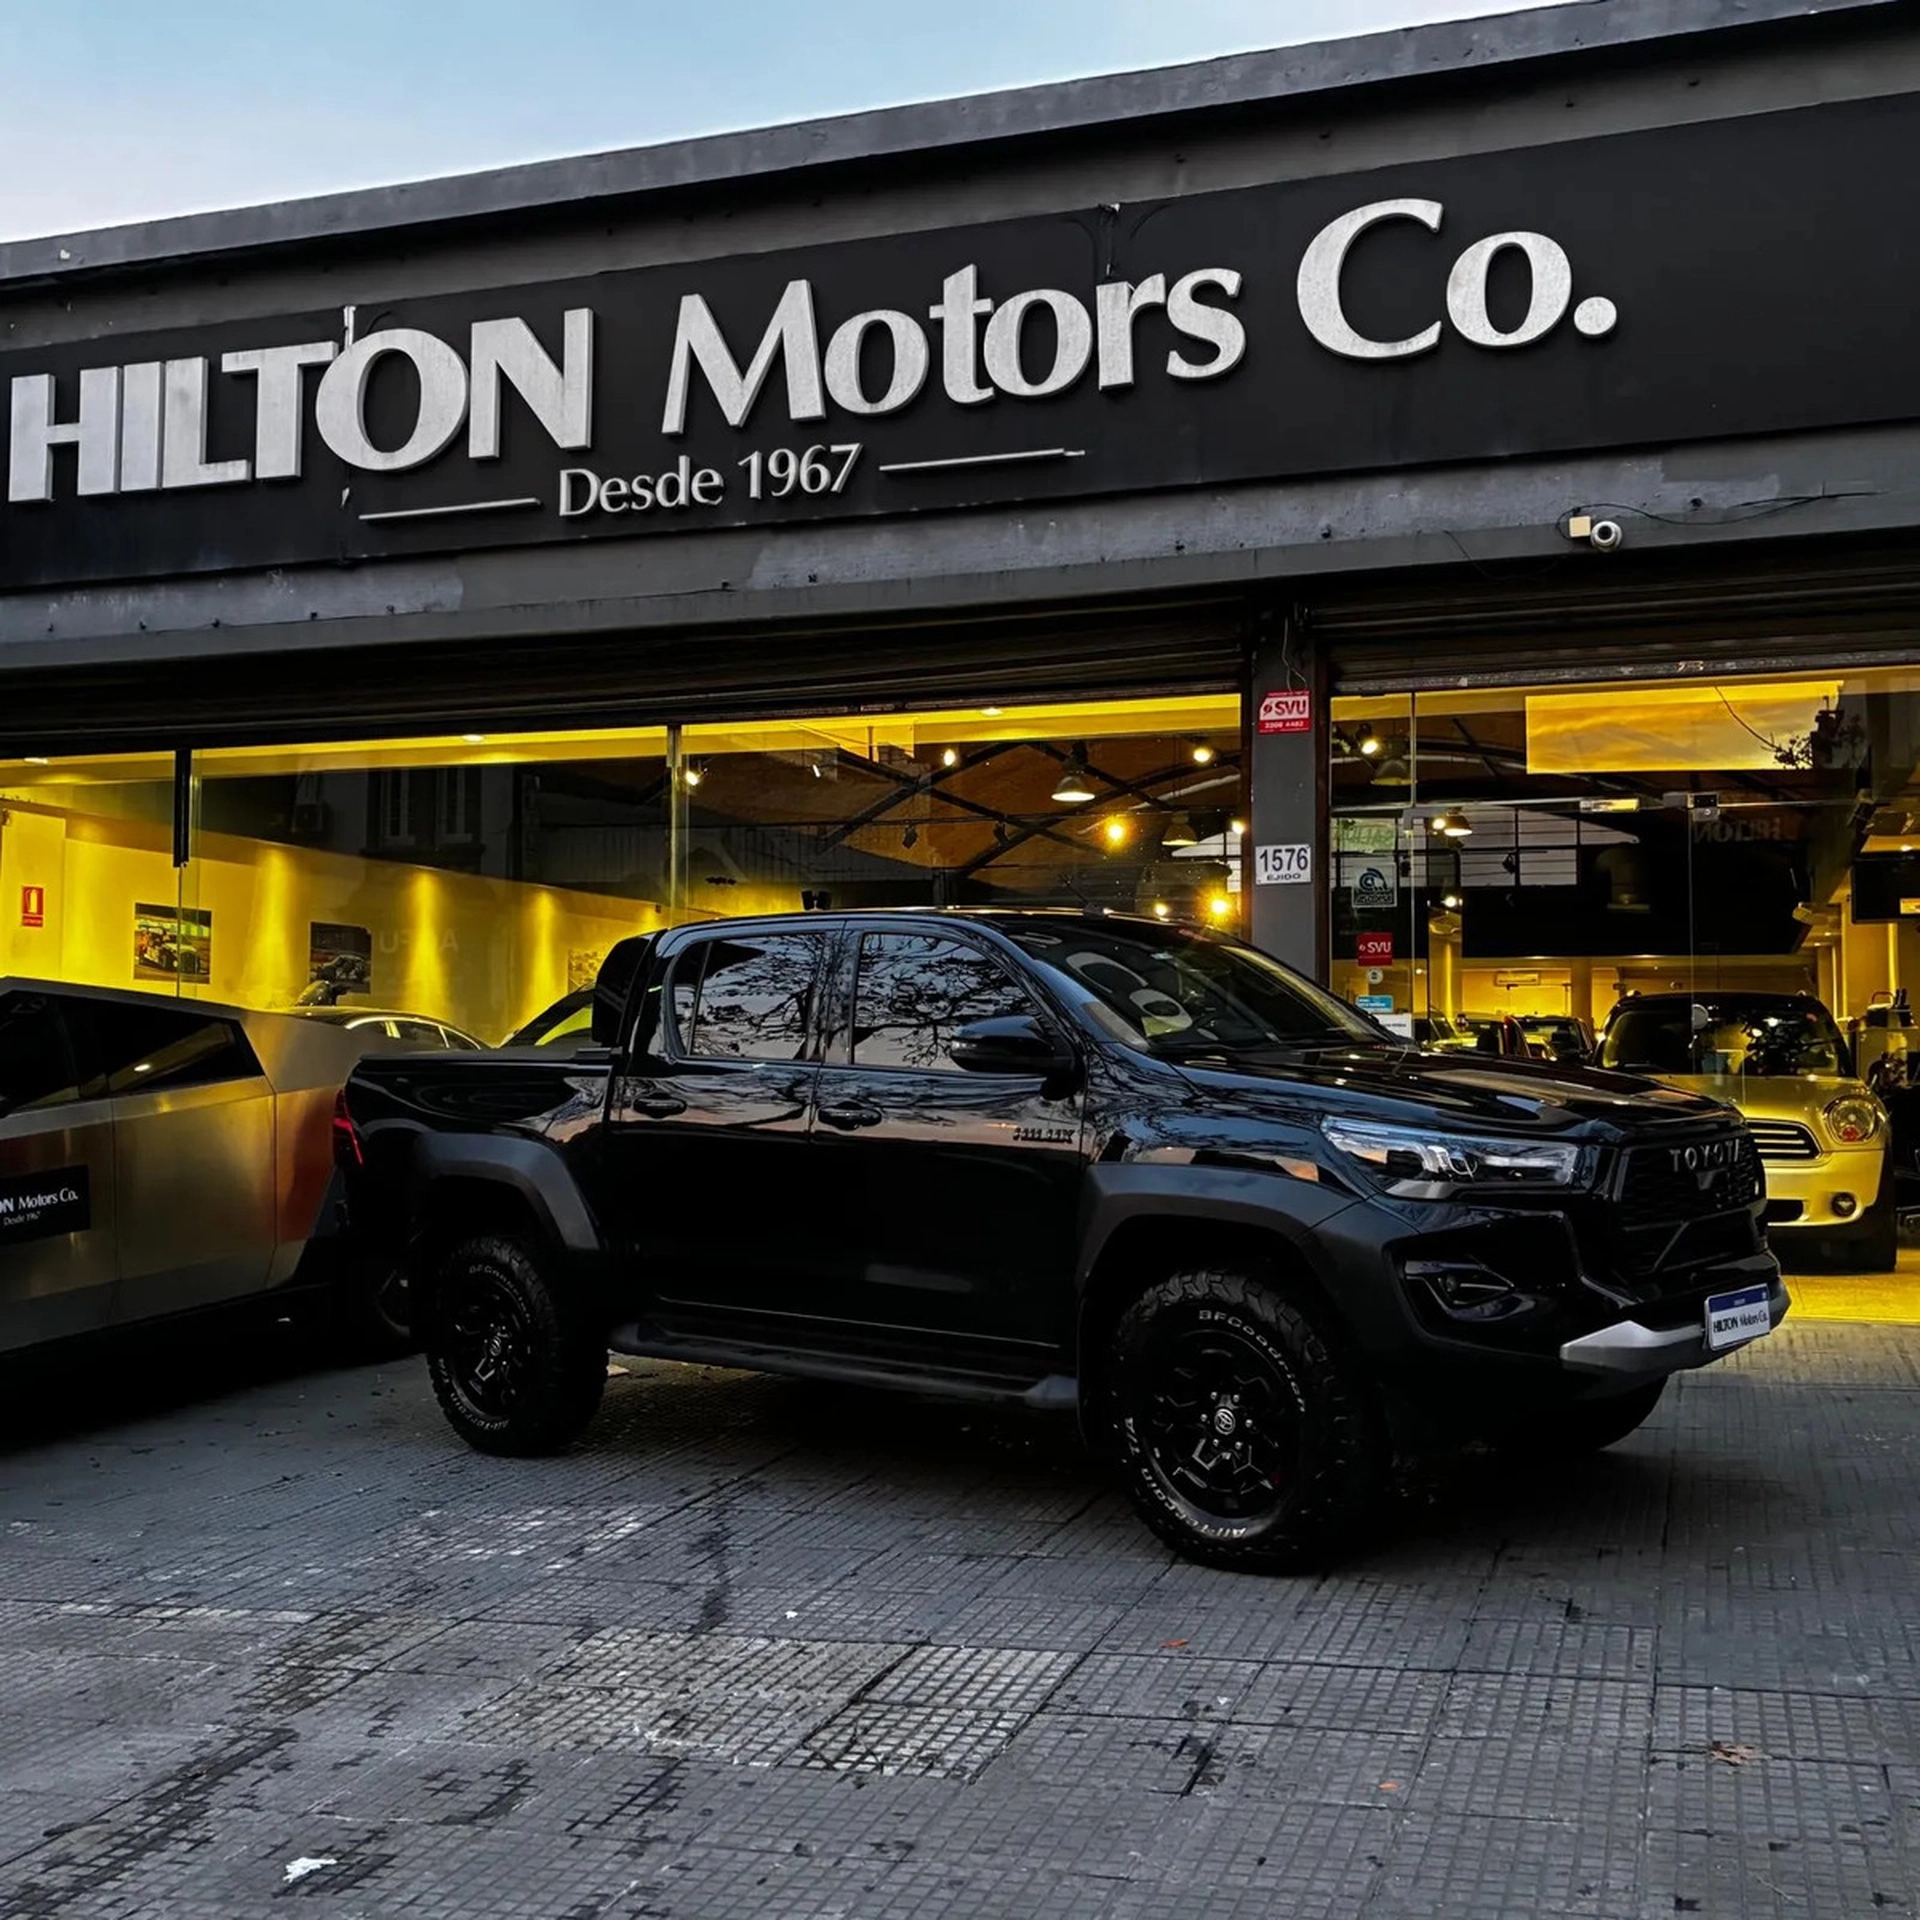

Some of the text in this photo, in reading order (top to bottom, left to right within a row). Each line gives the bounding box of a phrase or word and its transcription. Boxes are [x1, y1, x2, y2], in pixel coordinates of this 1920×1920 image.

[8, 199, 1618, 502] HILTON Motors Co.
[559, 443, 864, 517] Desde 1967
[1274, 700, 1306, 716] SVU
[1259, 847, 1309, 872] 1576
[1367, 941, 1391, 953] SVU
[19, 1193, 58, 1210] Motors
[60, 1188, 78, 1202] Co.
